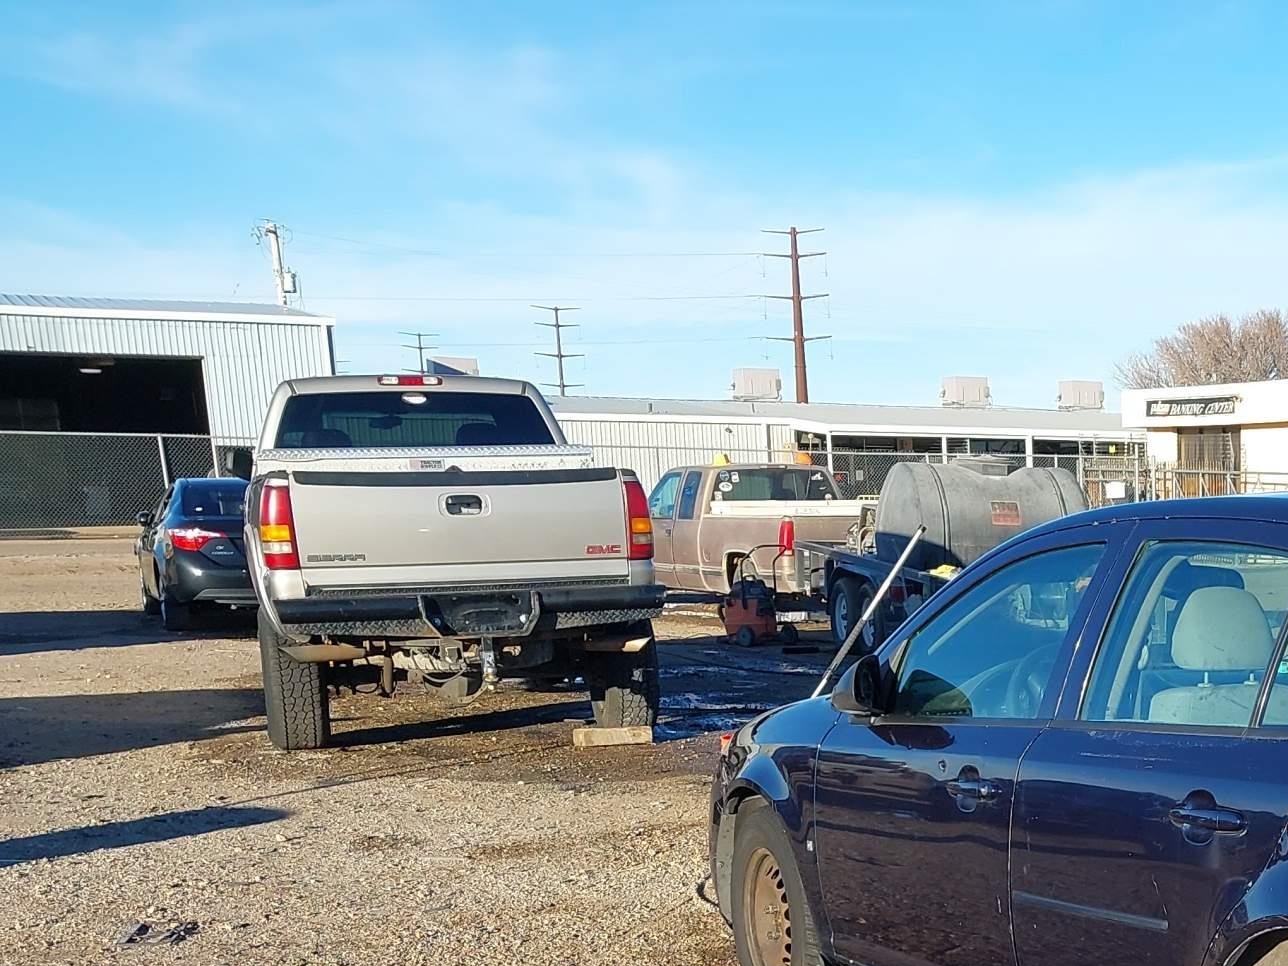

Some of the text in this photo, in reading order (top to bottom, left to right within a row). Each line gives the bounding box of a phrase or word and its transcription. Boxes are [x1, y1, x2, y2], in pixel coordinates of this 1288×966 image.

[1169, 403, 1204, 416] BANKING
[1205, 401, 1233, 414] CENTER
[586, 544, 622, 555] GMC
[306, 554, 366, 562] SIERRA
